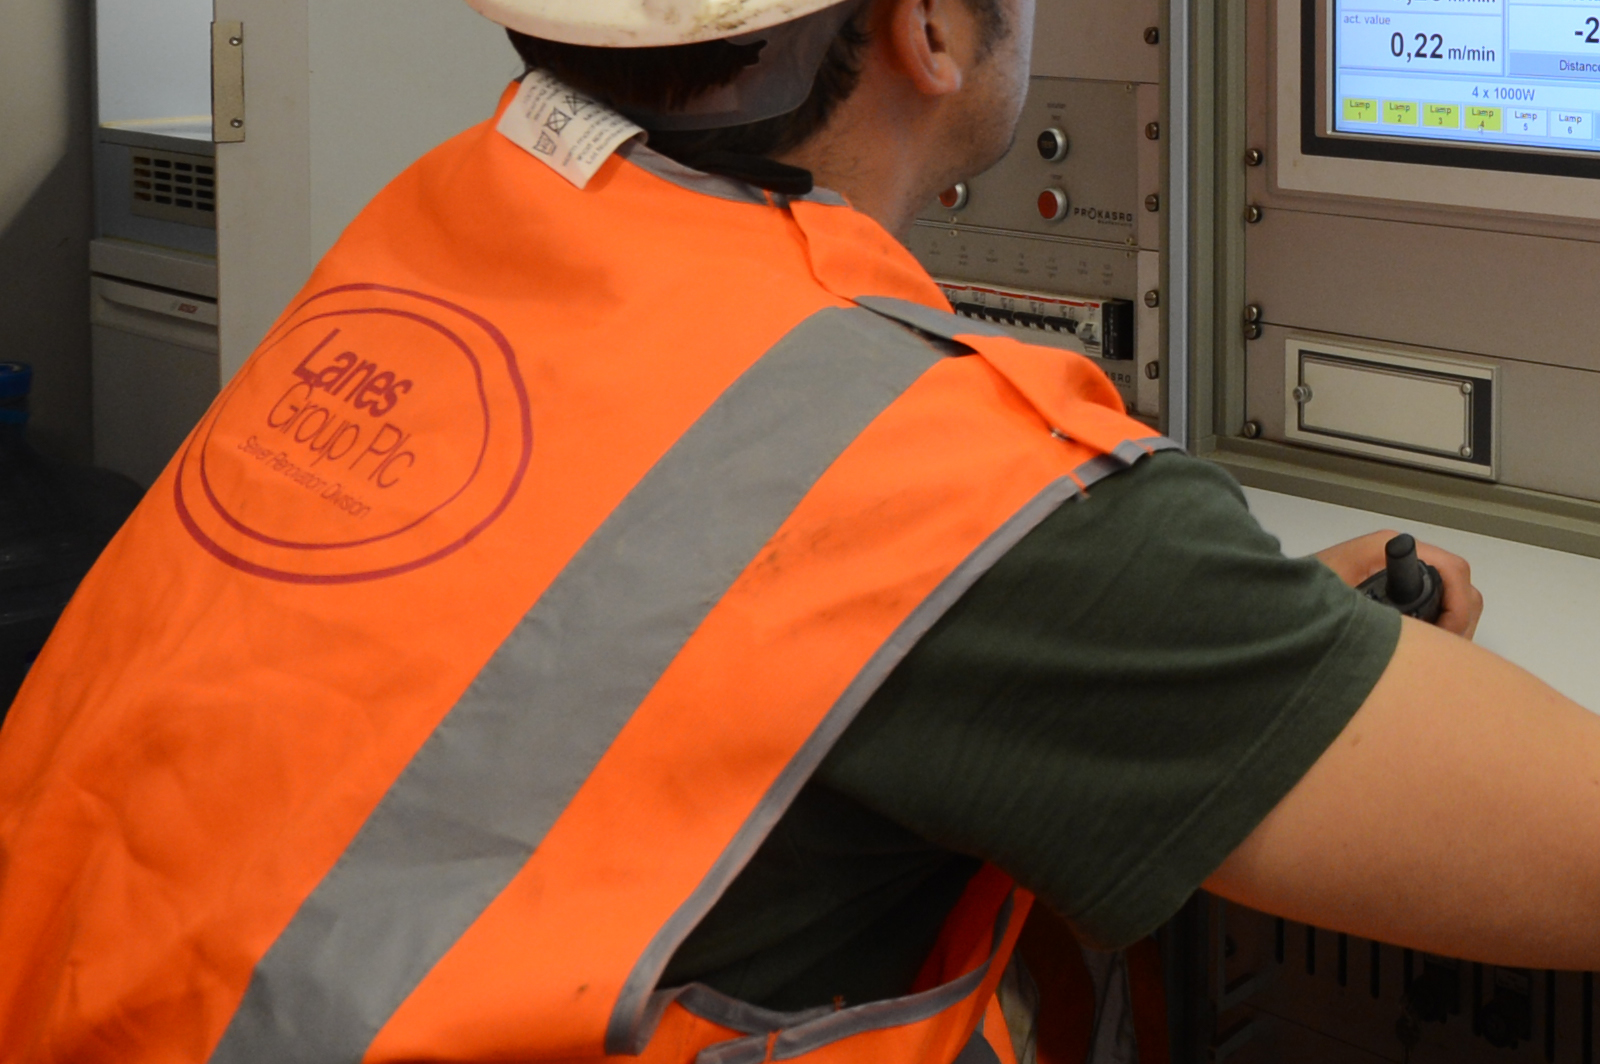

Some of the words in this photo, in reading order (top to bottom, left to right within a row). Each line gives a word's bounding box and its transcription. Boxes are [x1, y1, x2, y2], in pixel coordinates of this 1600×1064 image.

[1343, 14, 1361, 25] act.
[1364, 14, 1391, 25] value
[1390, 31, 1444, 63] 0,22
[1448, 45, 1496, 63] m/min
[1471, 86, 1479, 99] 4
[1482, 90, 1490, 99] x
[1494, 87, 1536, 101] 1000W
[1349, 99, 1371, 111] Lamp
[1389, 101, 1411, 113] Lamp
[1429, 104, 1452, 116] Lamp
[1471, 106, 1494, 119] Lamp
[1514, 109, 1538, 122] Lamp
[1558, 112, 1582, 125] Lamp
[1074, 207, 1133, 221] PROKASRO
[292, 328, 413, 418] Lanes
[267, 380, 360, 467] Group
[348, 423, 416, 489] Plc
